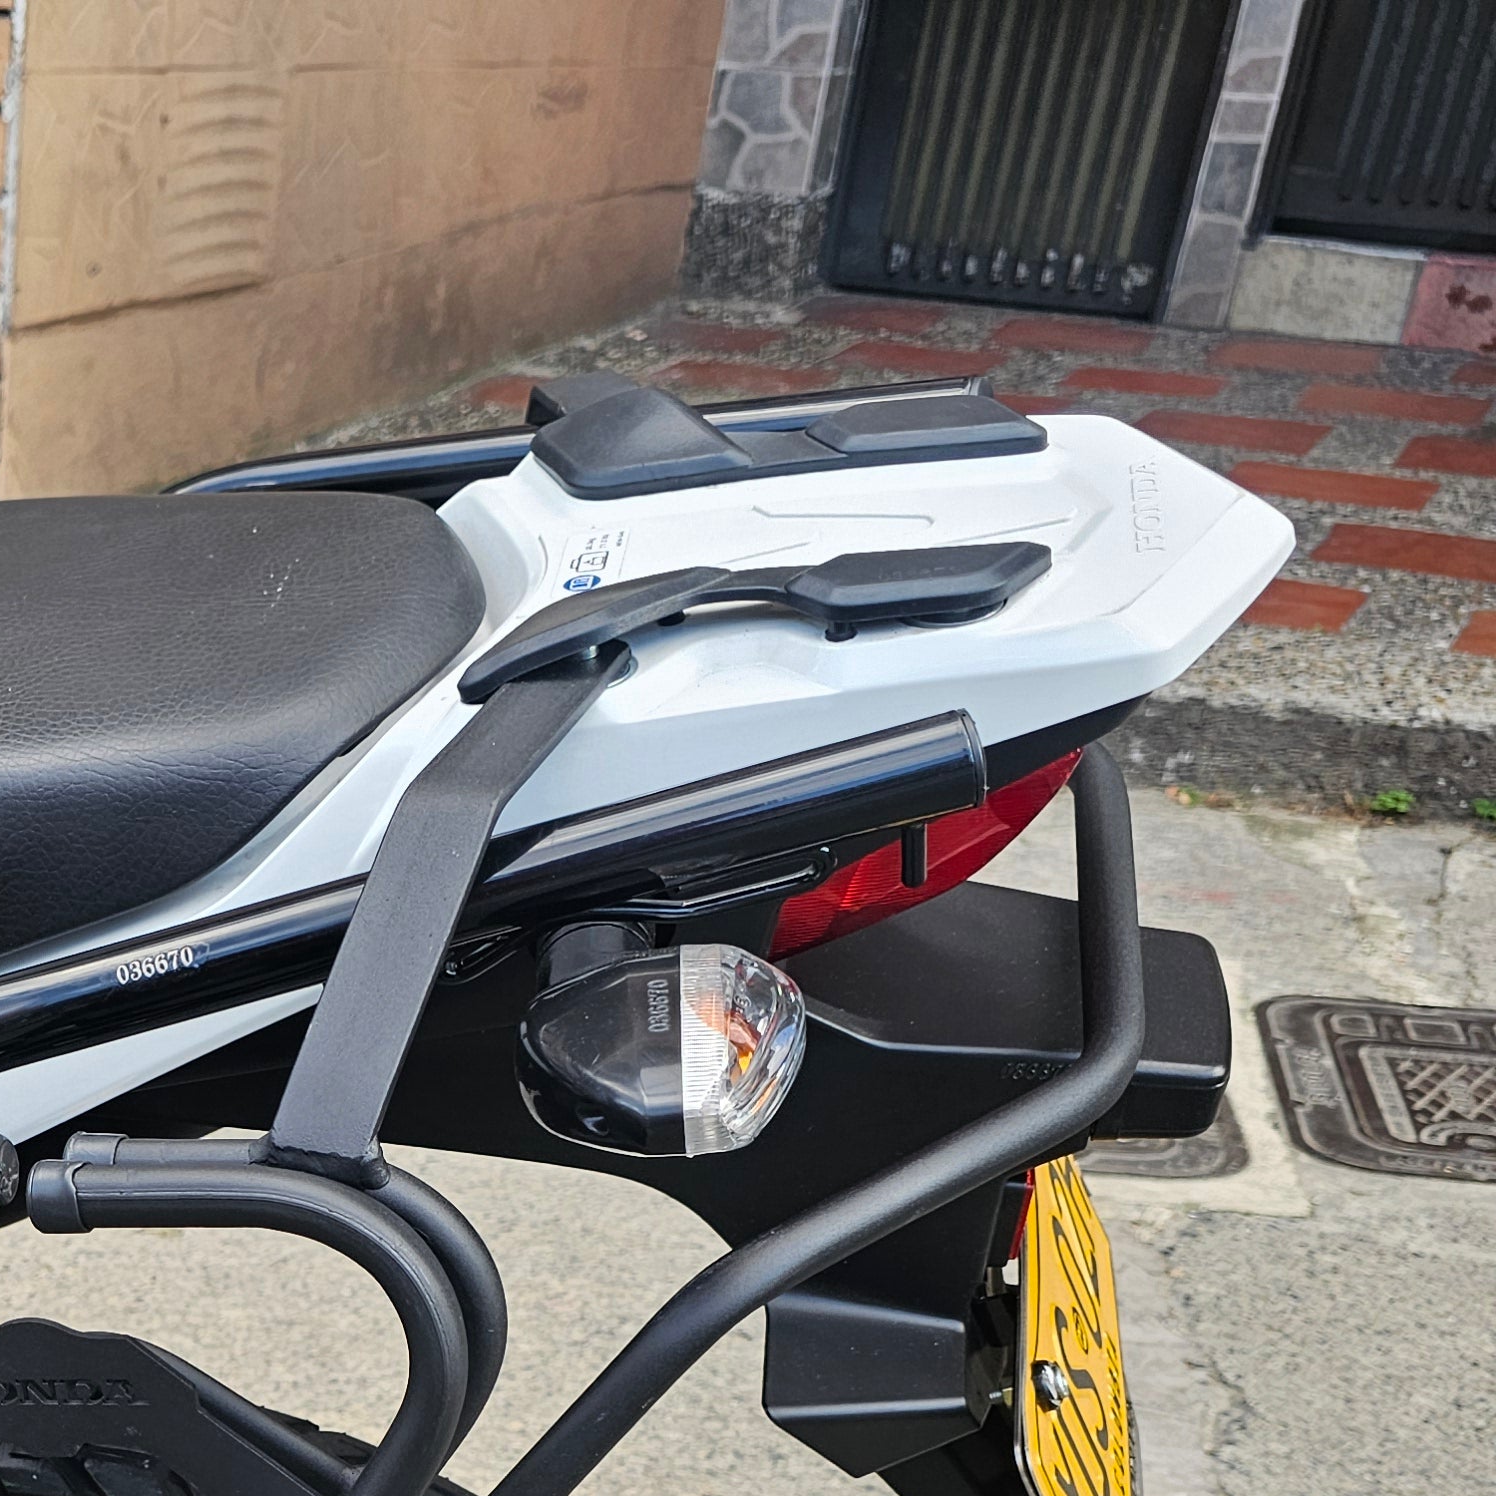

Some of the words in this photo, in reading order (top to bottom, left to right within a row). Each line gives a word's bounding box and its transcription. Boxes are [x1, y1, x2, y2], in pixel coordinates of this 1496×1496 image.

[1129, 460, 1166, 553] HONDA
[116, 946, 194, 985] 036670
[647, 979, 669, 1033] 036670
